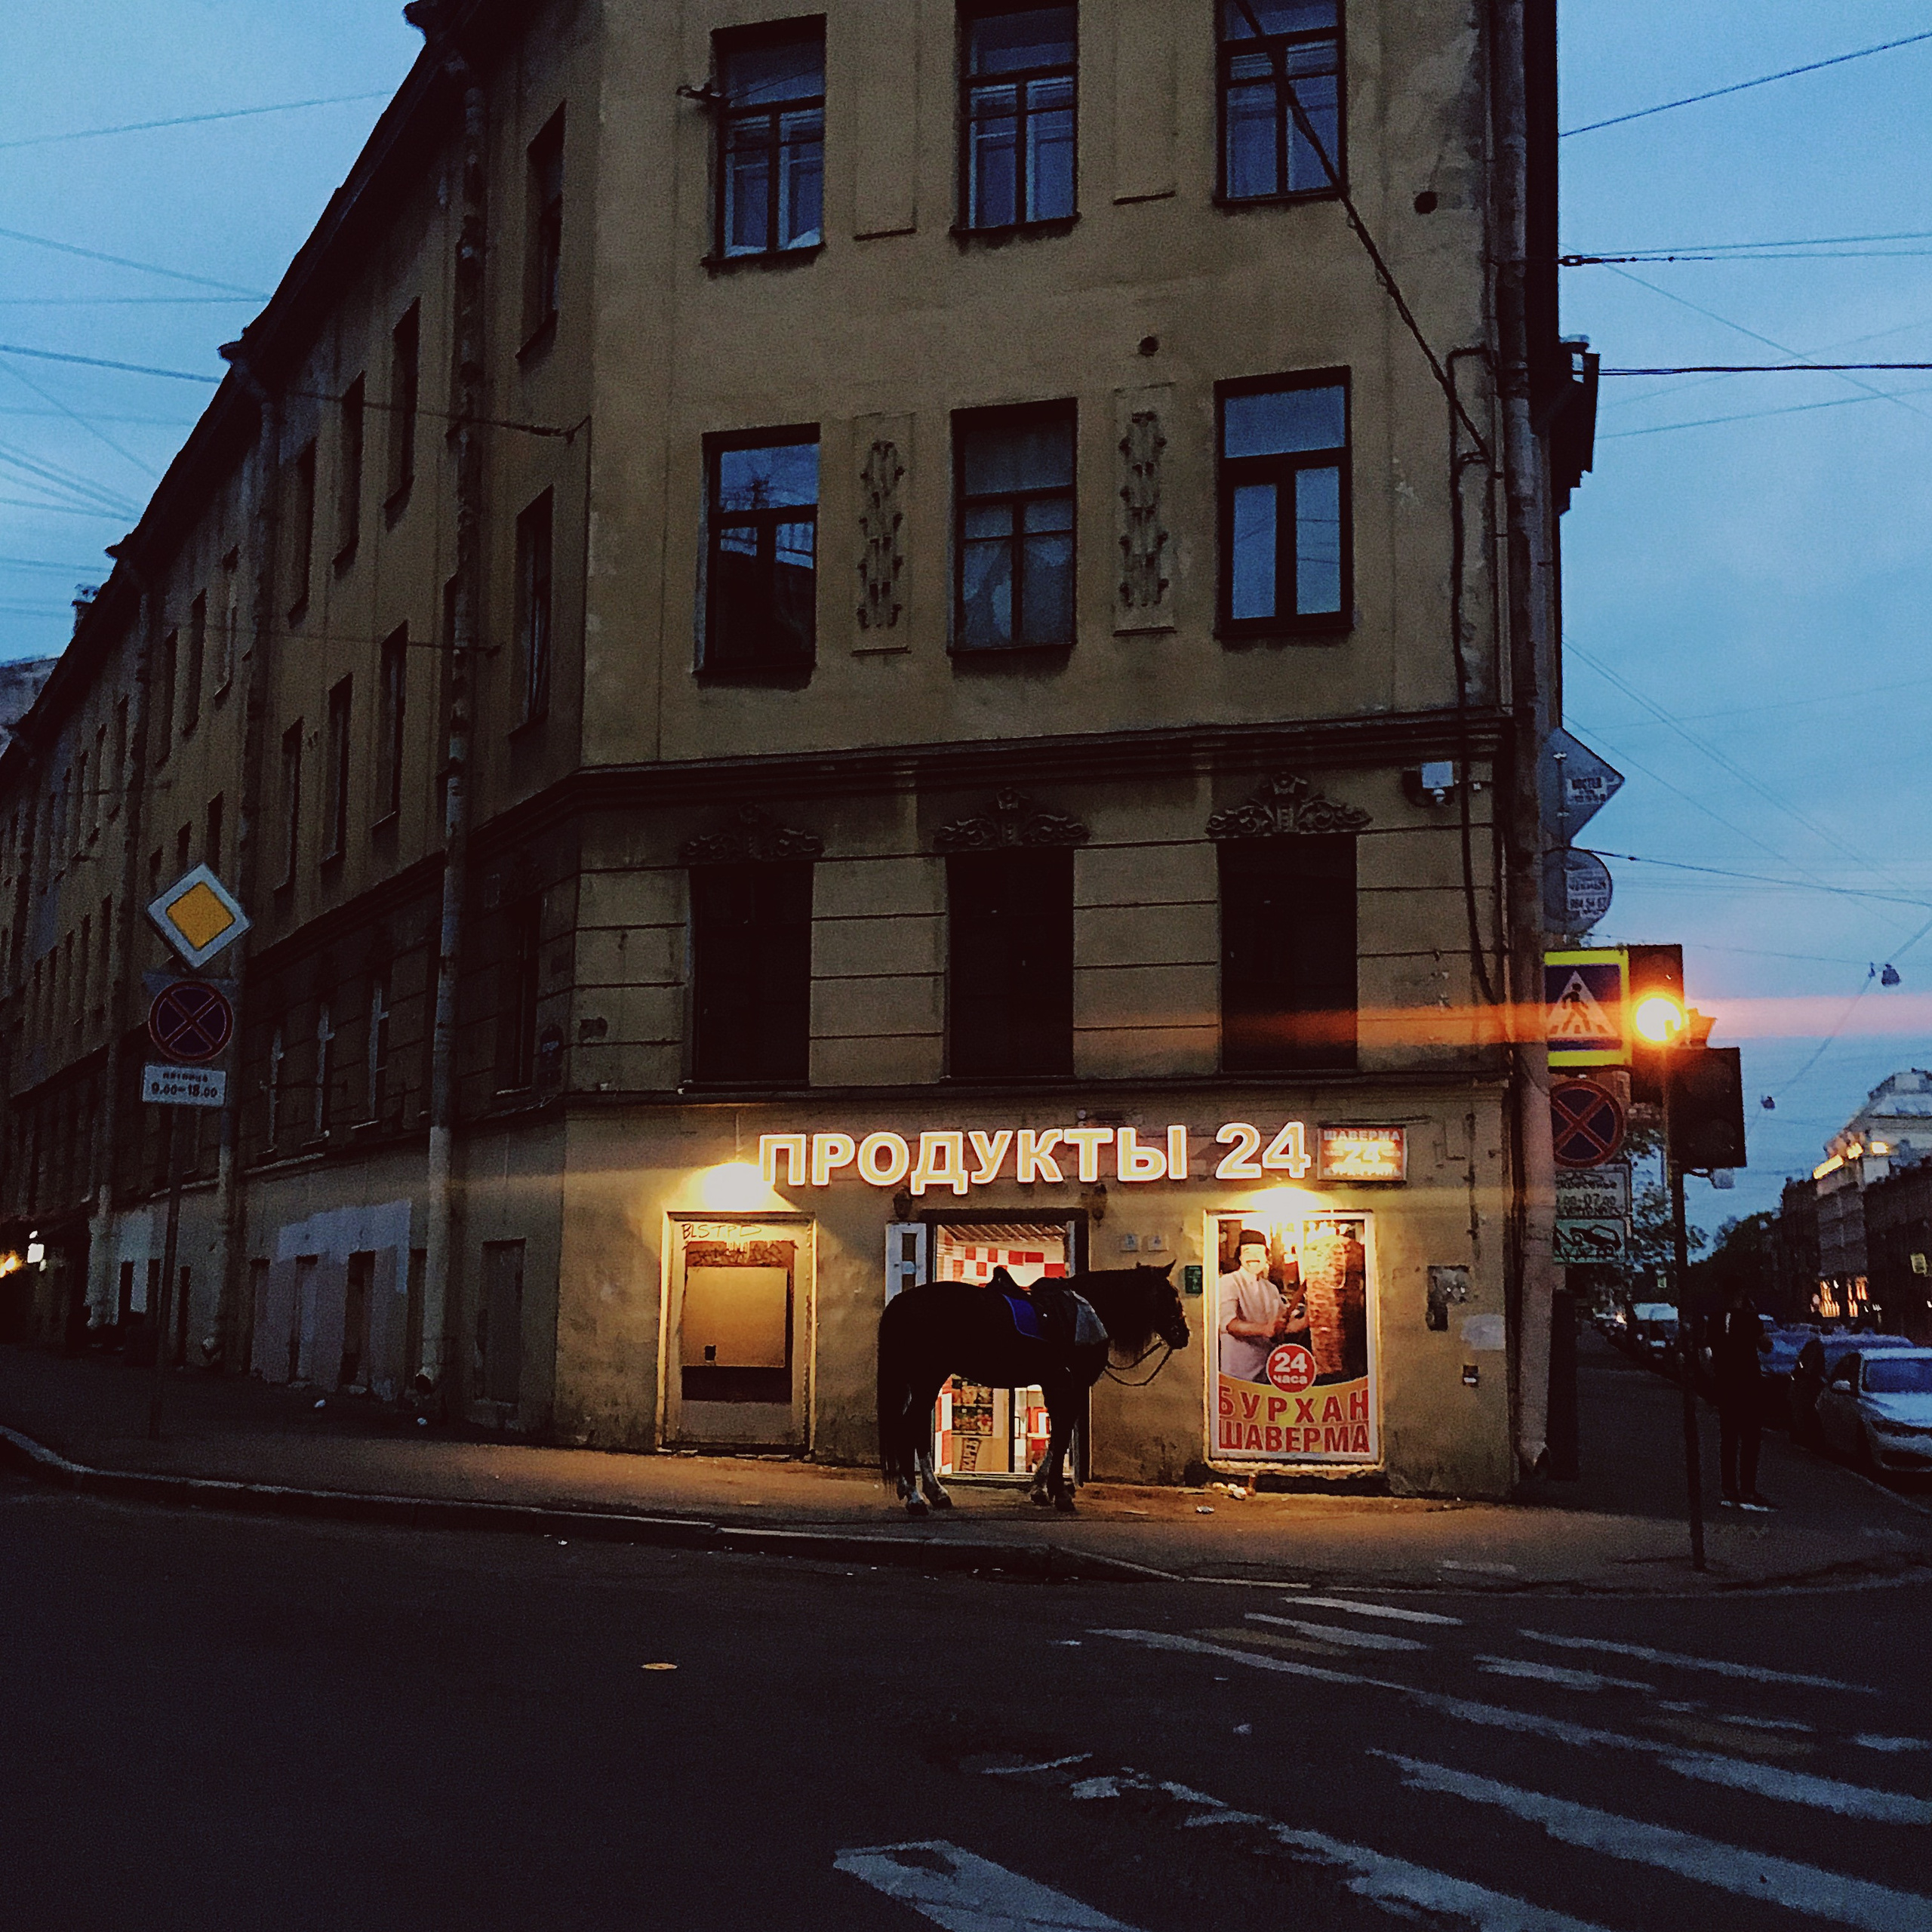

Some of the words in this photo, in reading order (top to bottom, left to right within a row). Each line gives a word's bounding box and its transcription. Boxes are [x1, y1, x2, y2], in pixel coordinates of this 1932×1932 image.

[1324, 1131, 1401, 1141] ШАВЕРМА
[759, 1124, 1187, 1195] ПРОДУКТЫ
[1215, 1121, 1312, 1180] 24
[1344, 1142, 1381, 1164] 24
[1274, 1352, 1308, 1374] 24
[1273, 1374, 1308, 1384] часа
[1219, 1384, 1369, 1423] БУРХАН
[1219, 1420, 1370, 1453] ШАВЕРМА
